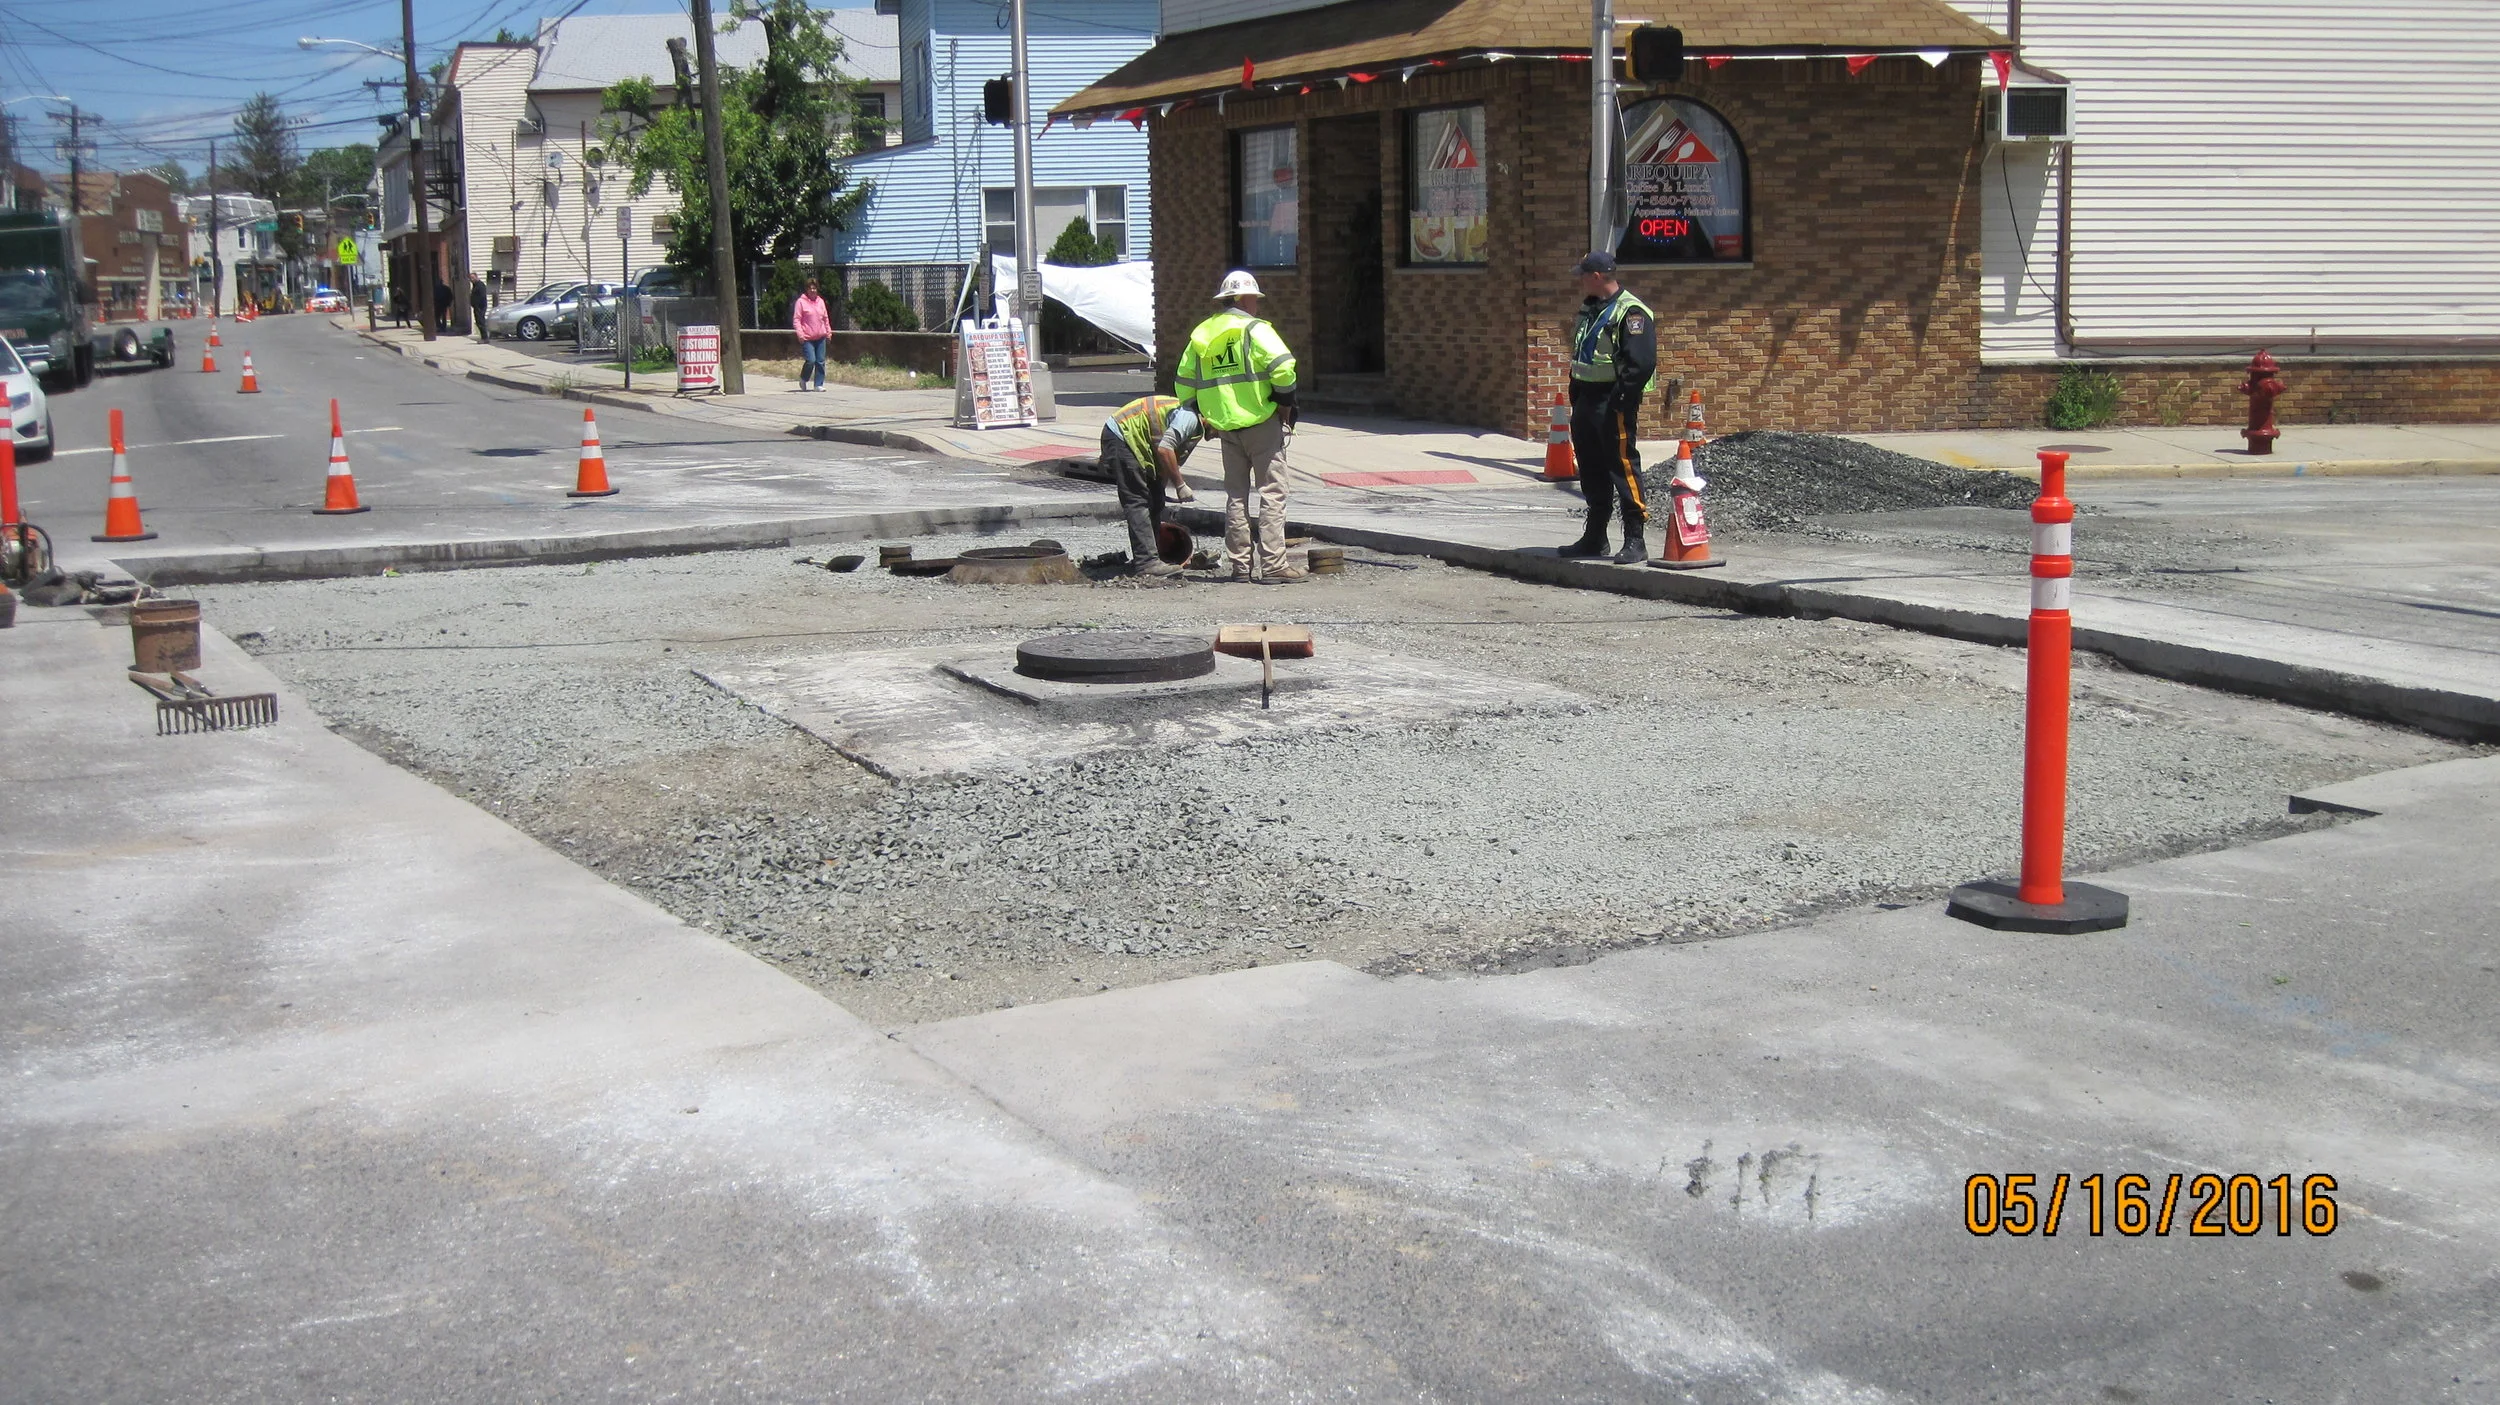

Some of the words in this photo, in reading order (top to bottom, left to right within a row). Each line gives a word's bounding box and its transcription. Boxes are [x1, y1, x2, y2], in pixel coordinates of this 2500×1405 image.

[1640, 219, 1687, 237] OPEN
[680, 338, 717, 350] CUSTOMER
[680, 351, 717, 362] PARKING
[684, 365, 714, 375] ONLY
